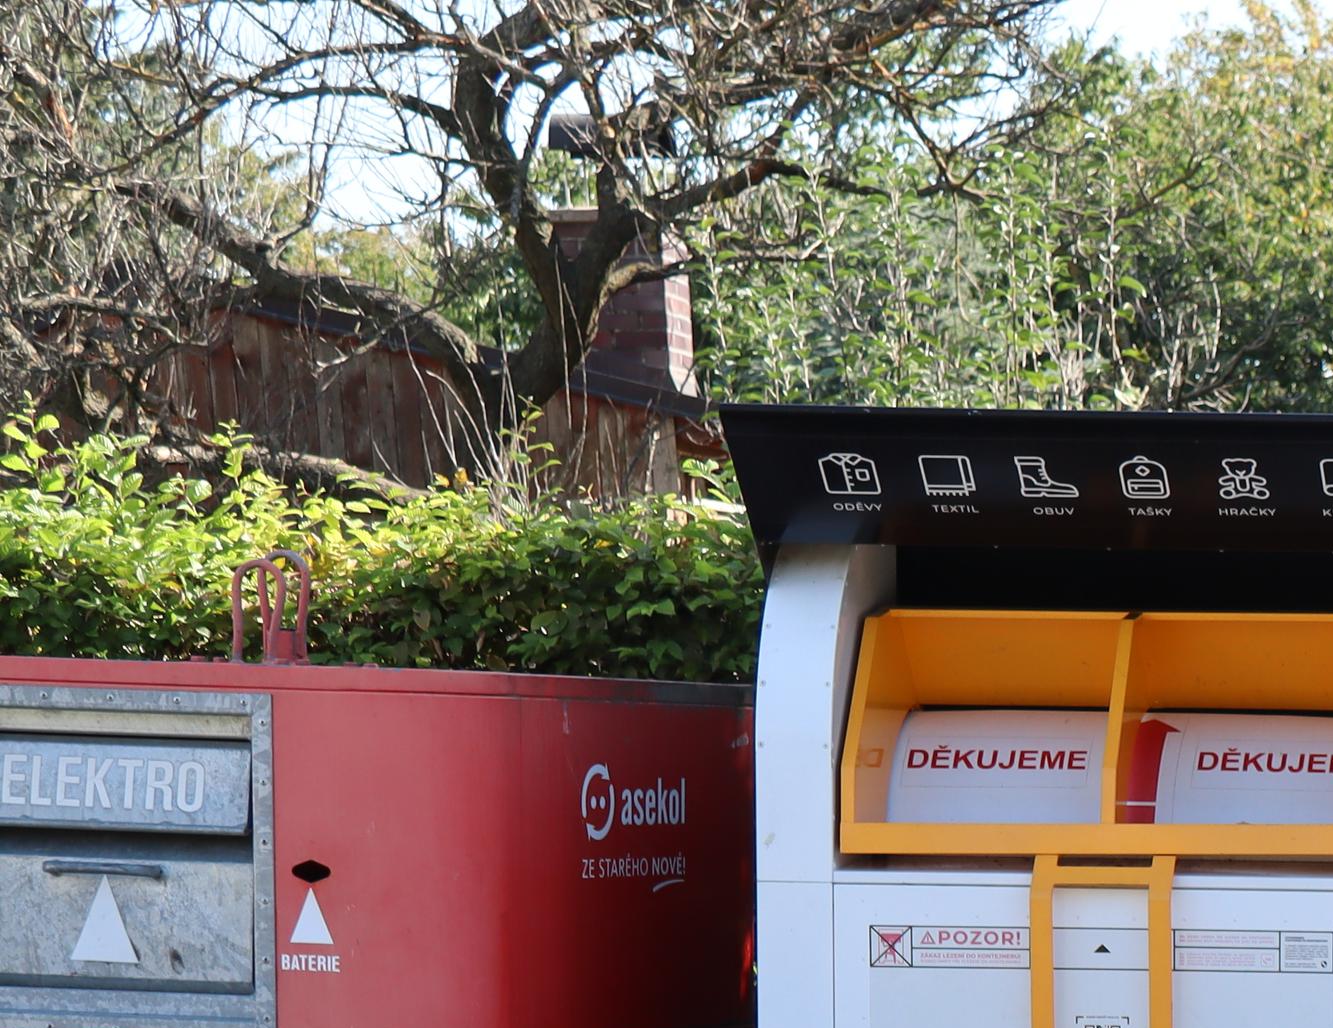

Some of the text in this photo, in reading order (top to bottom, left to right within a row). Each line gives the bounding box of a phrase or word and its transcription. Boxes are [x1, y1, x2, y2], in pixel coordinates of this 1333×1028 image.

[833, 502, 882, 512] ODĚVY
[931, 504, 979, 513] TEXTIL
[1032, 507, 1074, 516] OBUV
[1128, 506, 1172, 517] TAŠKY
[1218, 506, 1276, 517] HRAČKY
[906, 745, 1089, 770] DĚKUJEME
[2, 754, 206, 813] ELEKTRO
[621, 777, 686, 826] asekol
[582, 851, 686, 879] ZE STARÉHO NOVÉ!
[938, 930, 1021, 946] POZOR!
[281, 953, 341, 973] BATERIE
